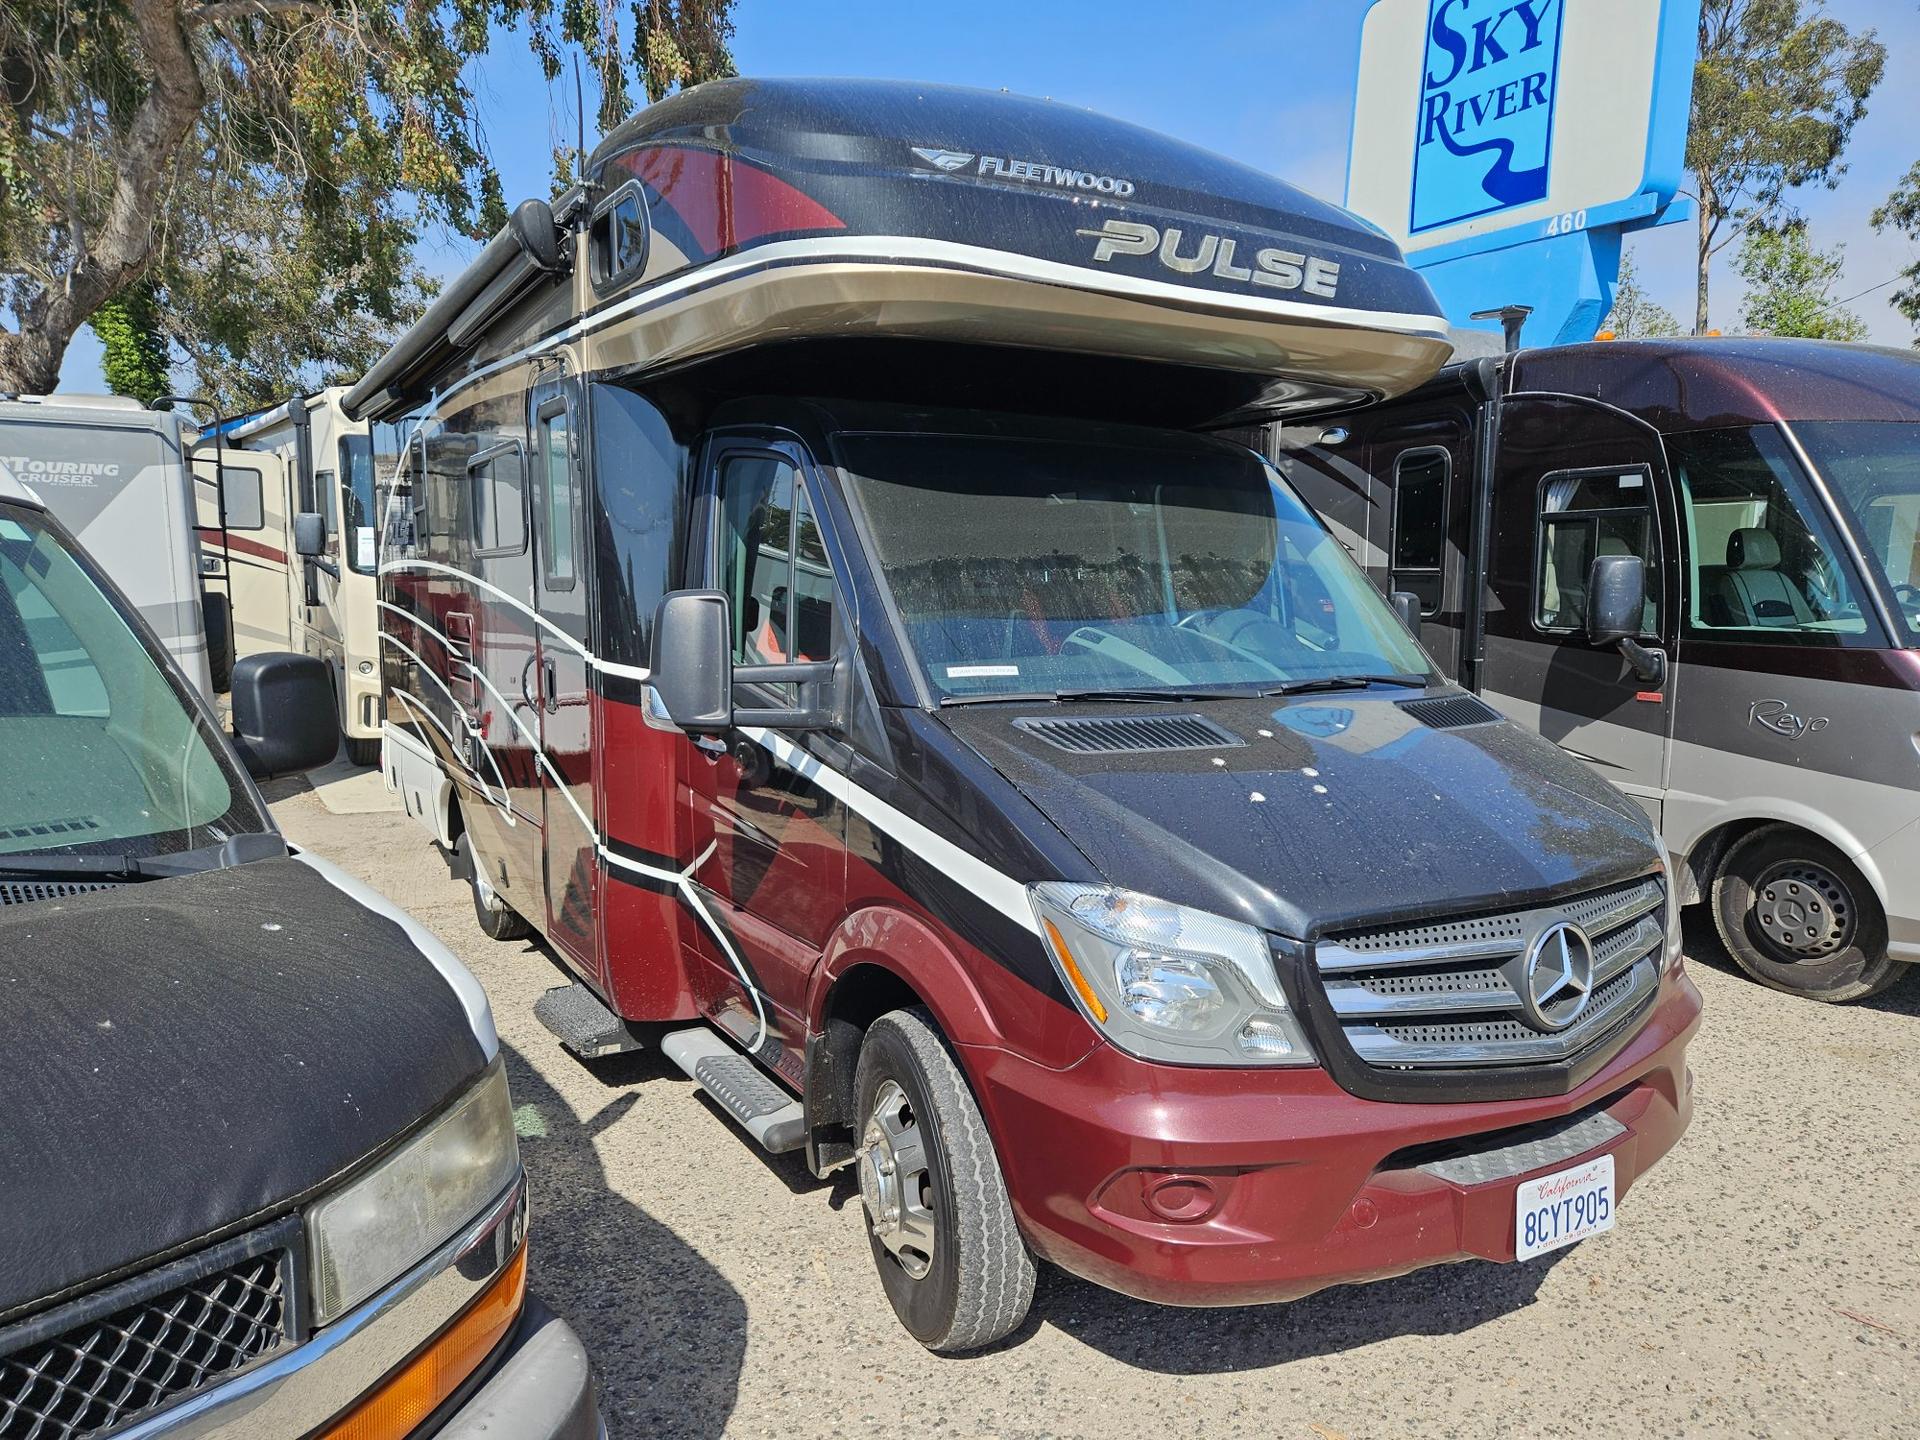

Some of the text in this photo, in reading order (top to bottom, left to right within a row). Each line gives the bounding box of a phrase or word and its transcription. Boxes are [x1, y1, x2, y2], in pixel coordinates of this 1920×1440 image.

[1426, 0, 1552, 90] SKY
[1421, 71, 1548, 147] RIVER
[977, 155, 1136, 197] FLEETWOOD
[1546, 209, 1587, 236] 460
[1076, 218, 1341, 299] PULSE
[17, 472, 95, 485] CRUISER
[1747, 698, 1830, 740] Reyo
[1537, 1172, 1598, 1200] California
[1524, 1185, 1609, 1247] 8CYT905
[1542, 1226, 1593, 1249] dmv.ca.gov
